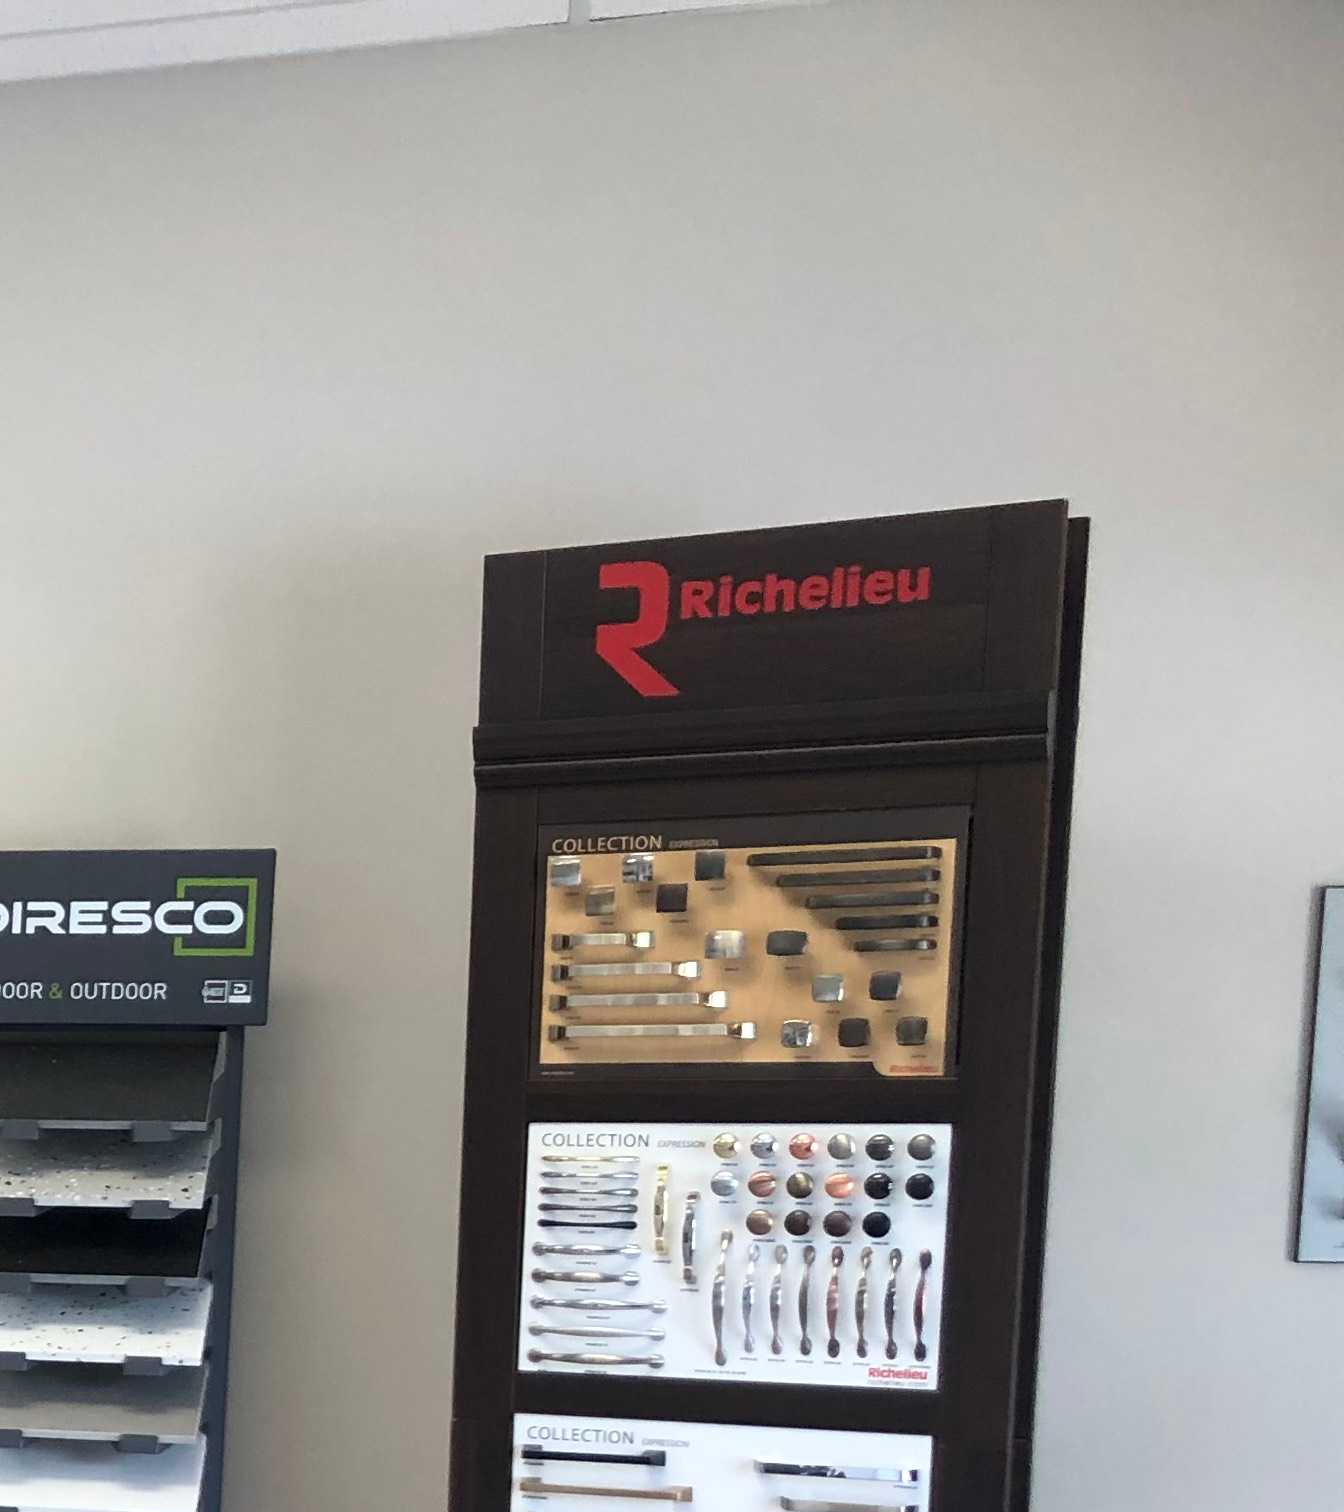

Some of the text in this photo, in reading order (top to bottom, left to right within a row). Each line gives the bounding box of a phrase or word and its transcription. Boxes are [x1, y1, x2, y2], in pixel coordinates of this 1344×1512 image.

[680, 564, 931, 619] Richelieu
[552, 835, 662, 853] COLLECTION
[49, 982, 62, 999] &
[70, 982, 167, 999] OUTDOOR
[542, 1133, 650, 1147] COLLECTION
[868, 1367, 928, 1380] Richelieu
[527, 1426, 634, 1444] COLLECTION
